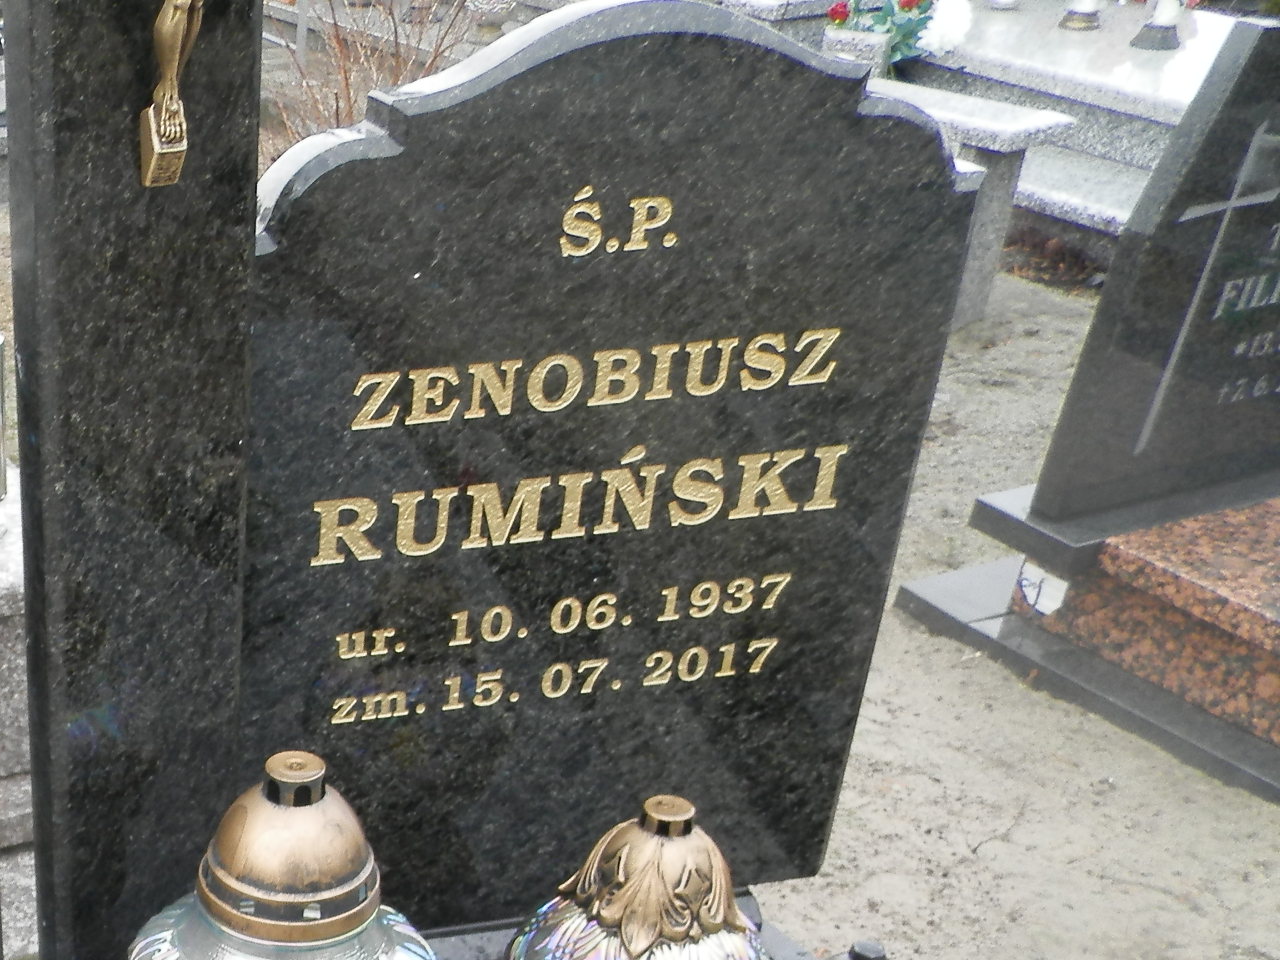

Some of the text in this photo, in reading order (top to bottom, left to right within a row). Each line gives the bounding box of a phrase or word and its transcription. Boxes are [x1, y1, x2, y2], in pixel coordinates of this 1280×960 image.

[558, 184, 679, 258] Ś.P.
[1213, 272, 1280, 320] FIL
[349, 326, 843, 431] ZENOBIUSZ
[309, 443, 850, 567] RUMIŃSKI
[334, 571, 793, 661] ur. 10. 06. 1937
[329, 636, 780, 726] zm. 15. 07. 2017
